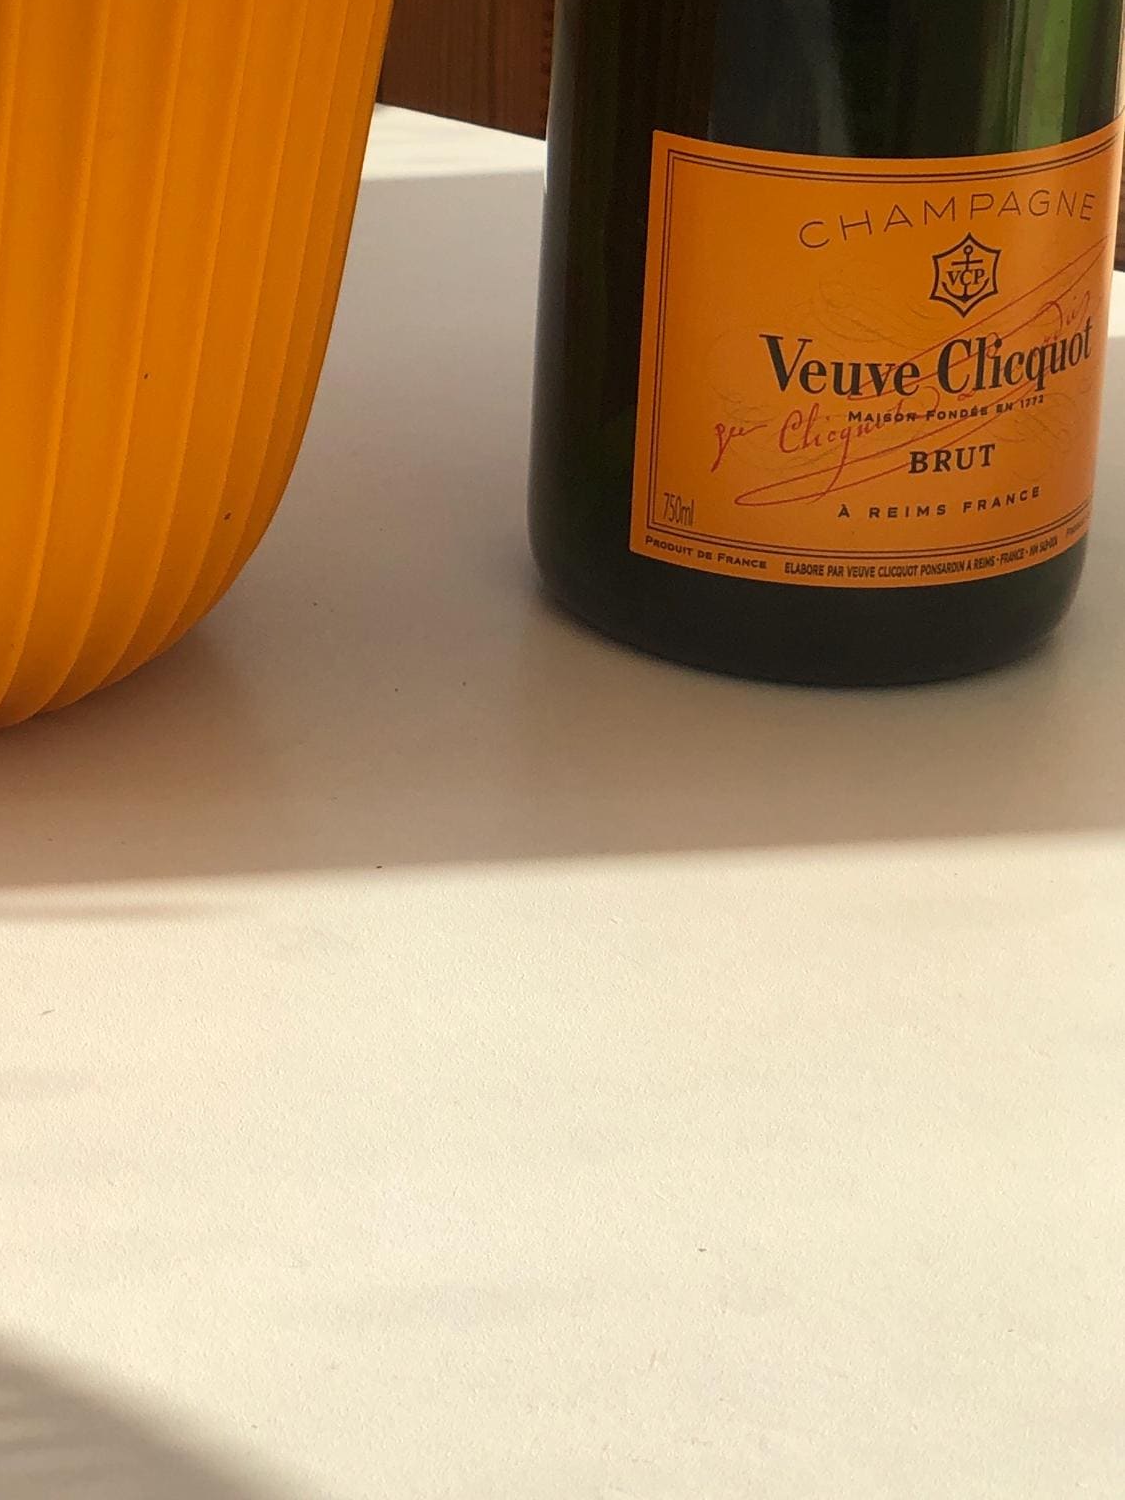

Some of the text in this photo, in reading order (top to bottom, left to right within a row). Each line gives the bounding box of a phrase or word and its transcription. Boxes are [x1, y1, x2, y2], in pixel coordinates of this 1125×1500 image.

[799, 189, 1096, 249] CHAMPAGNE
[947, 267, 986, 287] VCP
[760, 316, 1093, 398] Veuve Clicquot
[908, 444, 996, 474] BRUT
[663, 492, 695, 527] 750ml
[868, 504, 947, 519] REIMS
[963, 486, 1040, 513] FRANCE
[717, 553, 767, 569] FRANCE
[827, 565, 844, 578] PAR
[847, 566, 876, 579] VEUVE
[878, 565, 918, 578] CLICQUOT
